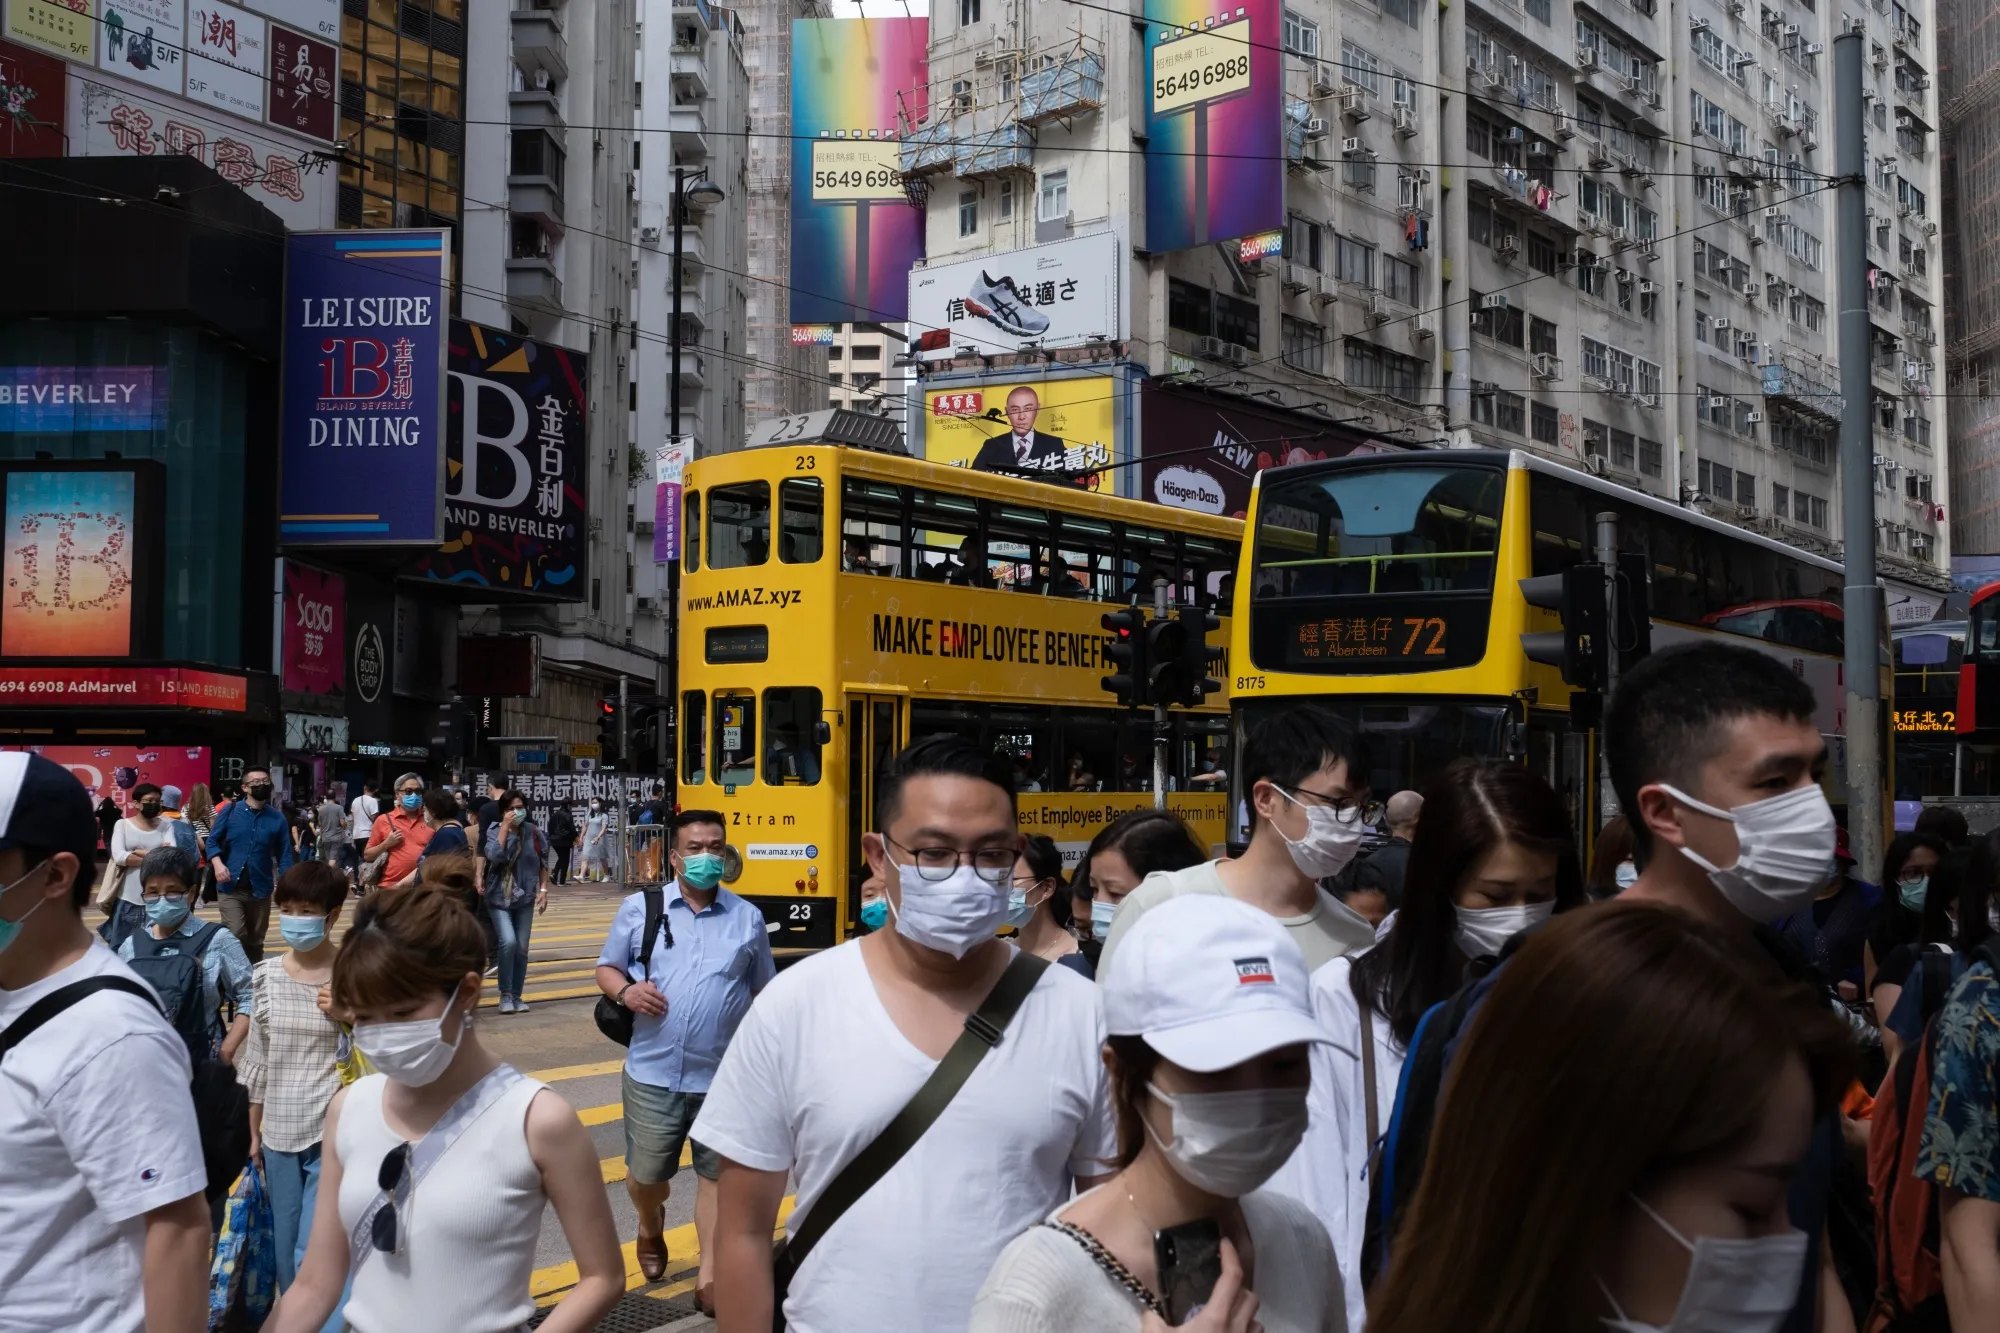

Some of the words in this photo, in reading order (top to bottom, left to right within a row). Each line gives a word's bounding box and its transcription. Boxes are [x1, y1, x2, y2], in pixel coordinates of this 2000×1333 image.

[201, 10, 237, 58] 潮
[318, 20, 336, 35] 6/F
[70, 42, 88, 56] 5/F
[156, 46, 180, 65] 5/F
[1155, 48, 1193, 70] 招租熱線
[189, 78, 208, 93] 5/F
[1155, 69, 1200, 99] 5649
[1203, 55, 1248, 86] 6988
[296, 115, 309, 127] 5F
[816, 152, 856, 163] 招租熱線
[815, 171, 862, 188] 5649
[865, 170, 902, 188] 698
[1240, 241, 1260, 258] 5649
[1260, 235, 1282, 254] 6988
[302, 296, 432, 327] LEISURE
[792, 329, 813, 342] 5649
[813, 329, 833, 342] 6988
[392, 336, 415, 400] 金百利
[0, 384, 137, 404] BEVERLEY
[938, 394, 976, 409] 馬百良
[316, 401, 356, 411] ISLAND
[361, 401, 413, 410] BEVERLEY
[308, 416, 420, 447] DINING
[768, 416, 810, 442] 23
[536, 394, 568, 518] 金百利
[1212, 429, 1254, 471] NEW
[795, 456, 815, 470] 23
[684, 473, 693, 488] 23
[488, 513, 566, 541] BEVERLEY
[687, 587, 802, 612] www.AMAZ.xyz
[873, 613, 933, 656] MAKE
[940, 620, 1040, 665] EMPLOYEE
[1299, 616, 1393, 644] 經香港仔
[1402, 617, 1446, 655] 72
[304, 632, 324, 657] 莎莎
[364, 646, 375, 659] THE
[1303, 646, 1319, 656] via
[1327, 643, 1387, 657] Aberdeen
[360, 658, 379, 673] BODY
[29, 681, 64, 693] 6908
[68, 679, 137, 693] AdMarvel
[360, 672, 378, 688] SHOP
[1236, 676, 1266, 690] 8175
[161, 681, 200, 696] ISLAND
[204, 684, 240, 700] BEVERLEY
[1897, 722, 1914, 731] Chai
[1916, 722, 1942, 731] North
[358, 744, 367, 755] THE
[1042, 805, 1102, 828] Employee
[1205, 806, 1214, 820] in
[750, 847, 804, 858] www.amaz.xyz
[789, 905, 811, 920] 23
